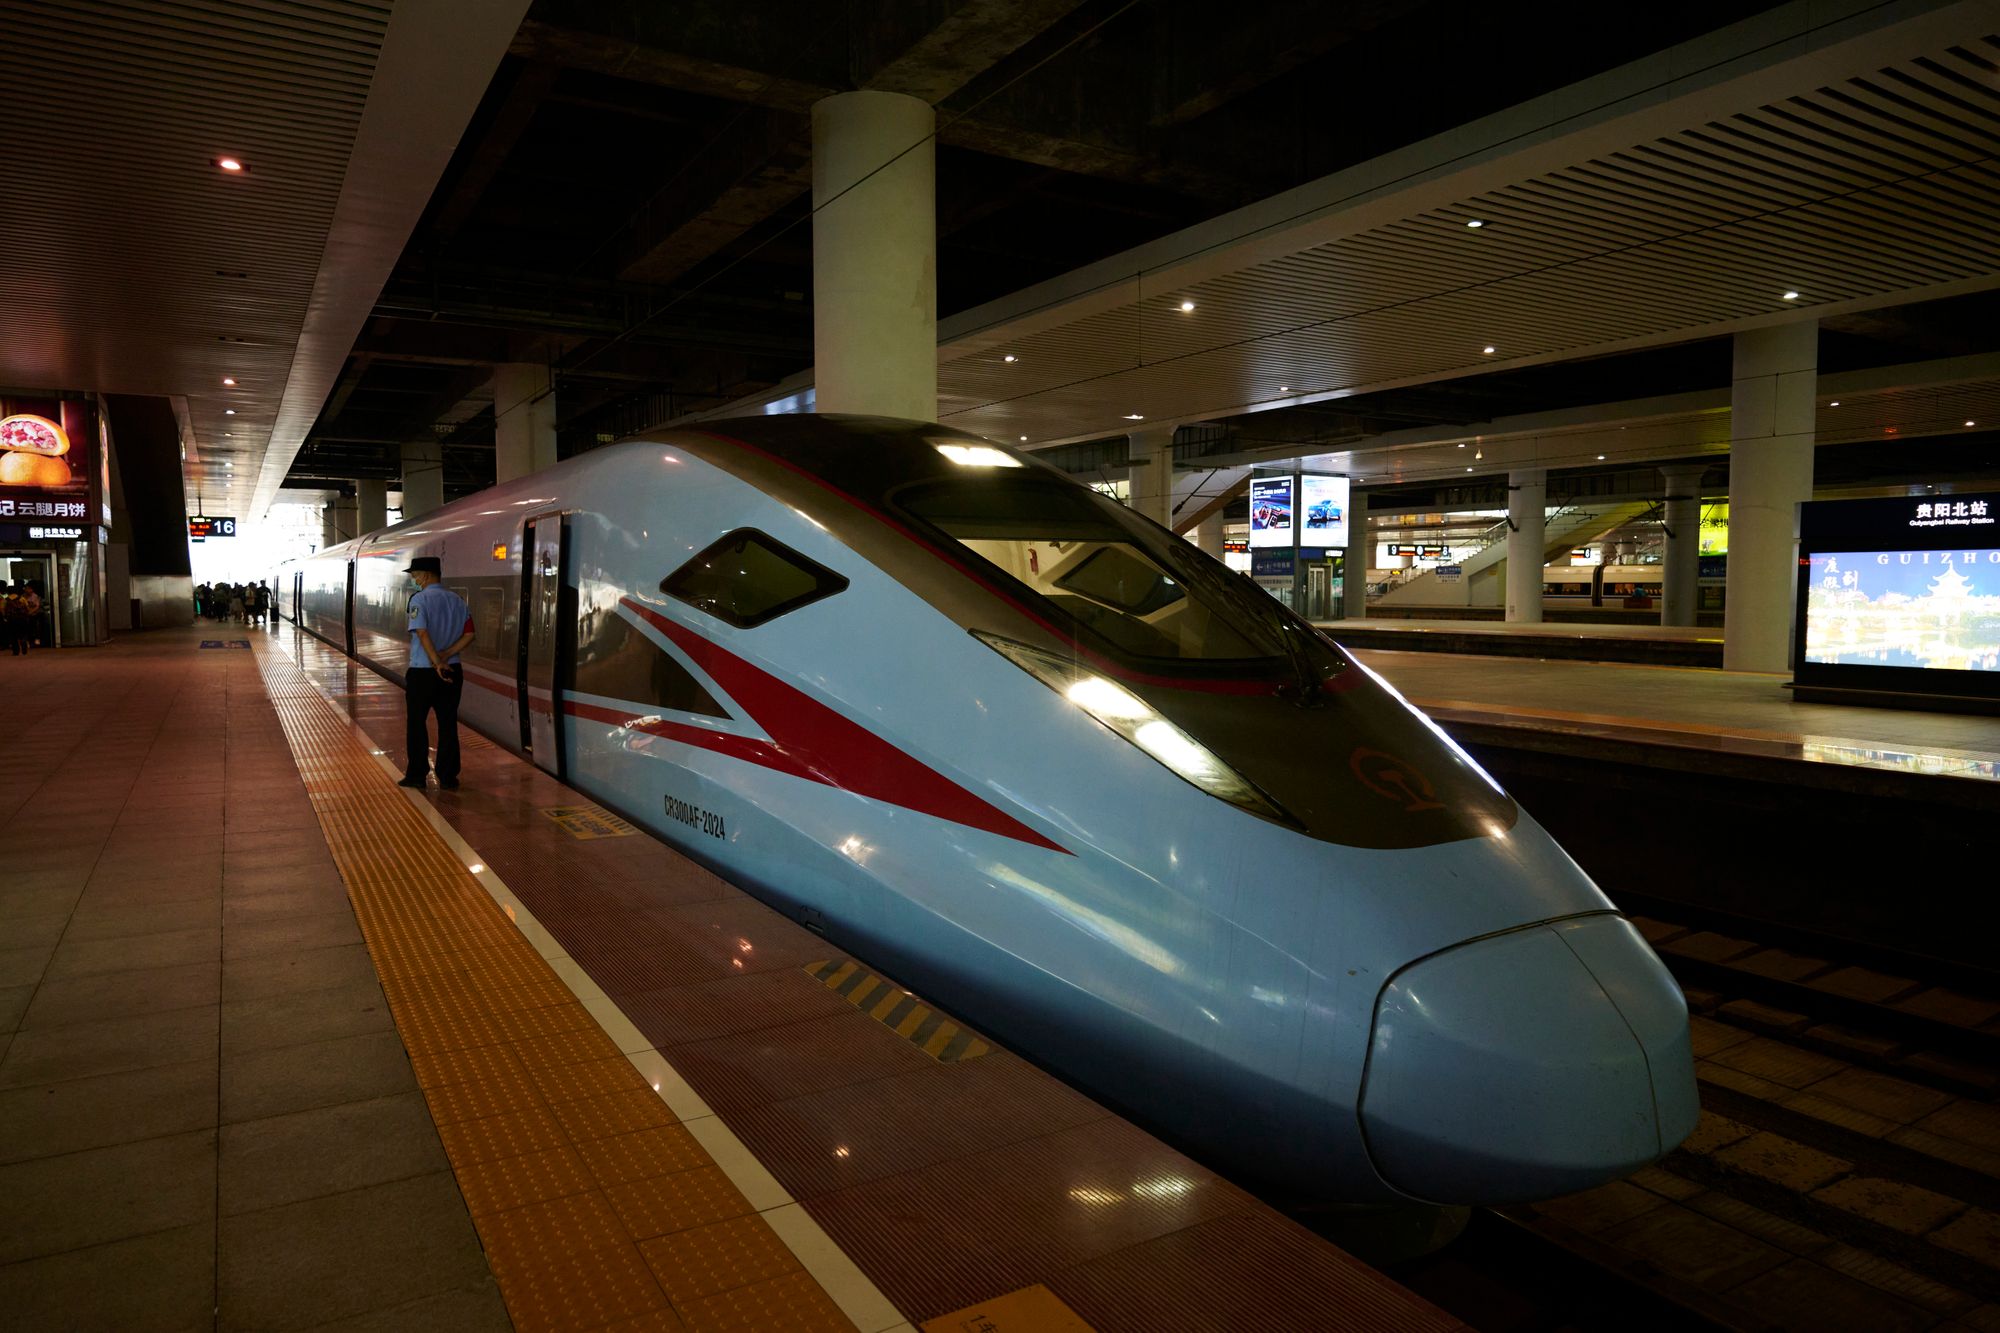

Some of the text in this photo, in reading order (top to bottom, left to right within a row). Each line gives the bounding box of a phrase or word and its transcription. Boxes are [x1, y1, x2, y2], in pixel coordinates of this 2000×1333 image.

[18, 502, 86, 517] 云腿月饼
[1916, 500, 1988, 519] 贵阳北站
[214, 520, 234, 534] 16
[1909, 519, 1944, 527] Guiyangbei
[664, 794, 726, 840] CR300AF-2024
